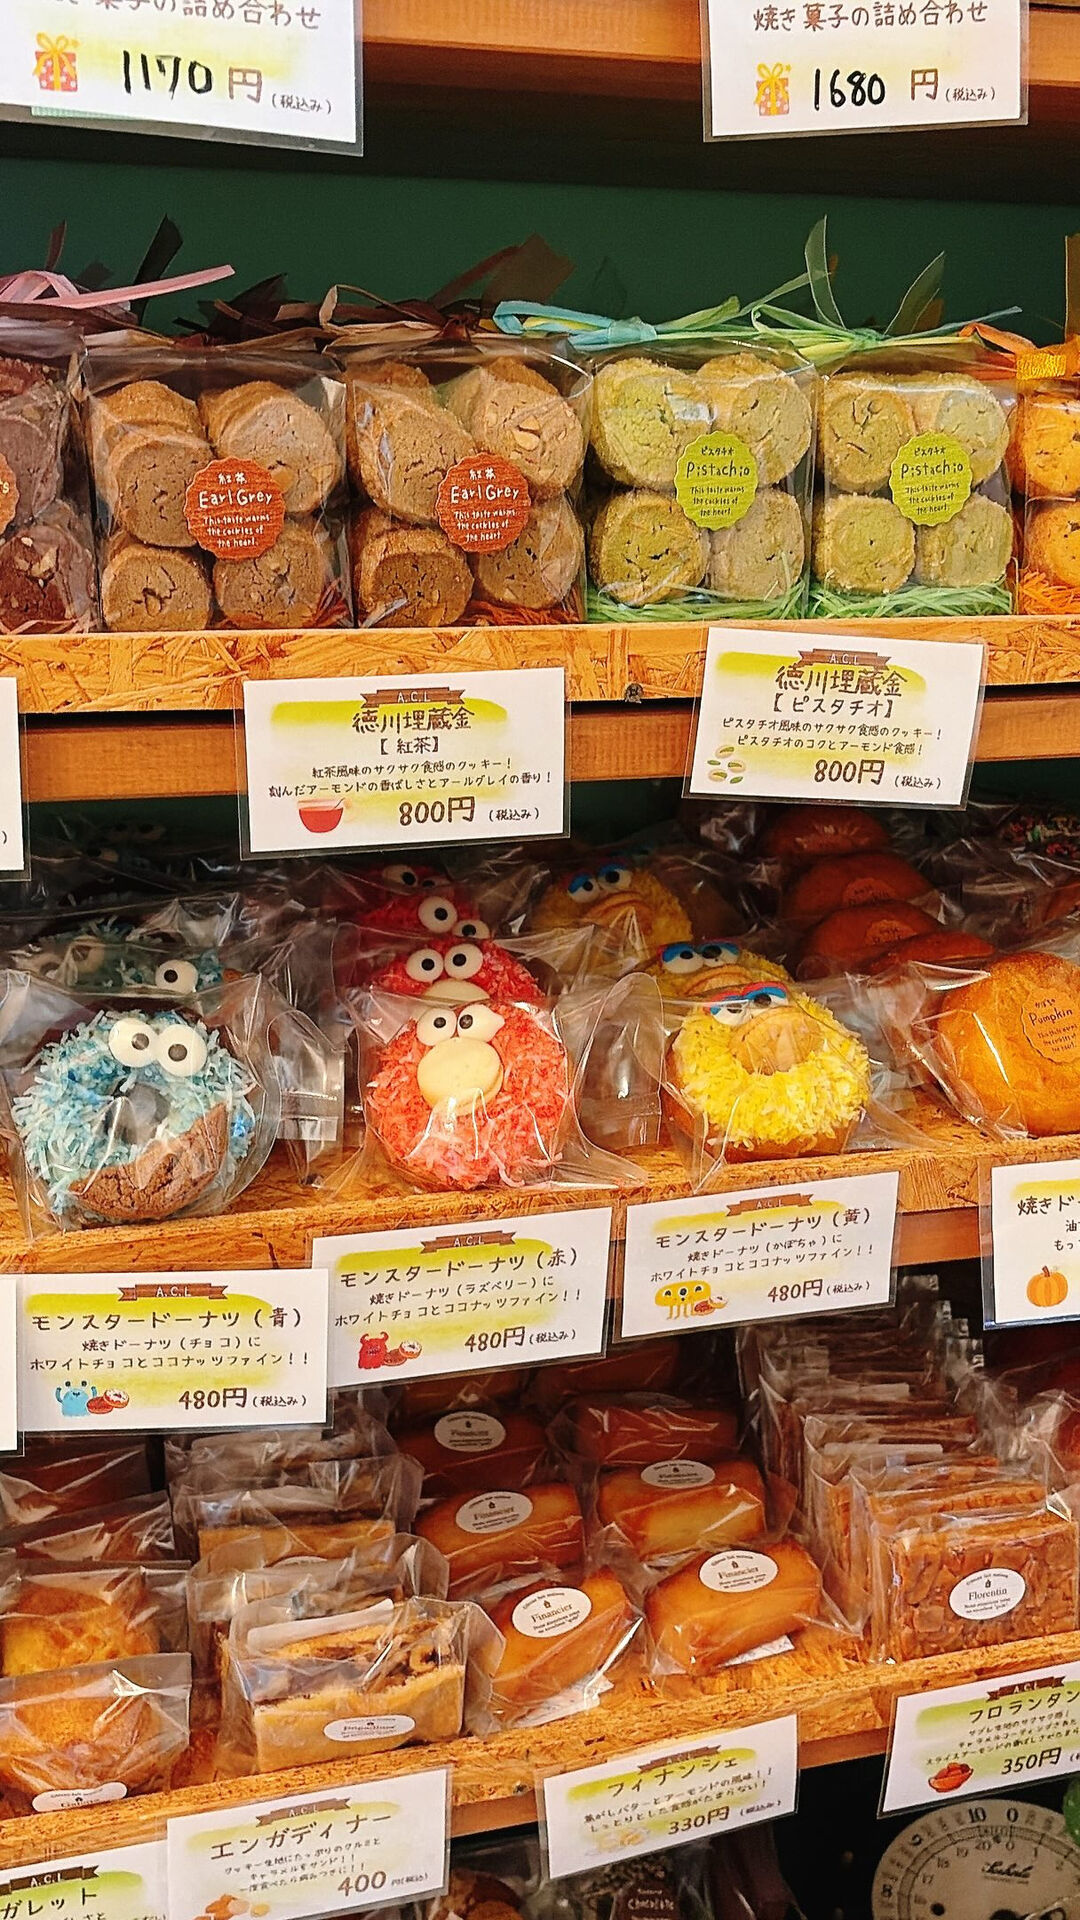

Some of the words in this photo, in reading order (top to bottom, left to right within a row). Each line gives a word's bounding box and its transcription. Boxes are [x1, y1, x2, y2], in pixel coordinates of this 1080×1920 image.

[753, 0, 988, 32] 焼き菓子の詰め合わせ
[122, 50, 213, 100] 1170
[228, 66, 263, 103] 円
[813, 68, 886, 111] 1680
[911, 68, 939, 101] 円
[686, 459, 750, 478] Pistachio
[901, 459, 964, 479] Pistachio
[199, 489, 233, 508] Earl
[236, 489, 272, 506] Grey
[451, 485, 482, 504] Earl
[485, 484, 519, 500] Grey
[255, 524, 264, 534] of
[828, 653, 860, 666] A.C.L
[775, 665, 908, 698] 徳川埋蔵金
[397, 690, 431, 704] A.C.L
[773, 693, 894, 718] 【ピスタチオ】
[352, 706, 475, 734] 徳川埋蔵金
[722, 717, 942, 741] ピスタチオ風味のサクサク食感のクッキー！
[380, 736, 440, 755] 【紅茶】
[737, 734, 923, 756] ピスタチオのコクとアーモンド食感！
[312, 758, 512, 779] 紅茶風味のサクサク食感のクッキー！
[813, 759, 885, 785] 800円
[399, 796, 476, 827] 800円
[1028, 1006, 1073, 1027] Pumpkin
[1017, 1194, 1080, 1217] 焼きド
[656, 1207, 871, 1249] モンスタードーナツ（黄）
[453, 1234, 485, 1248] A.C.L
[687, 1233, 842, 1263] 焼きドーナツ（かぼちゃ）に
[1053, 1239, 1080, 1252] もっ
[340, 1247, 579, 1289] モンスタードーナツ（赤）
[155, 1285, 192, 1298] A.C.L
[369, 1275, 555, 1307] 焼きドーナツ（ラズベリー）に
[767, 1278, 824, 1304] 480円
[31, 1306, 304, 1332] モンスタードーナツ（青）
[81, 1336, 261, 1352] 焼きドーナツ（チョコ）に
[464, 1326, 526, 1353] 480円
[178, 1386, 249, 1411] 480円
[968, 1587, 1008, 1601] Florentin
[530, 1603, 573, 1623] Financier
[1000, 1747, 1063, 1776] 350円
[607, 1756, 738, 1798] フィナンシェ
[668, 1805, 731, 1836] 330円
[967, 1806, 987, 1823] 10
[1006, 1806, 1019, 1823] 0
[210, 1813, 393, 1861] エンガディナー
[337, 1870, 388, 1898] 400
